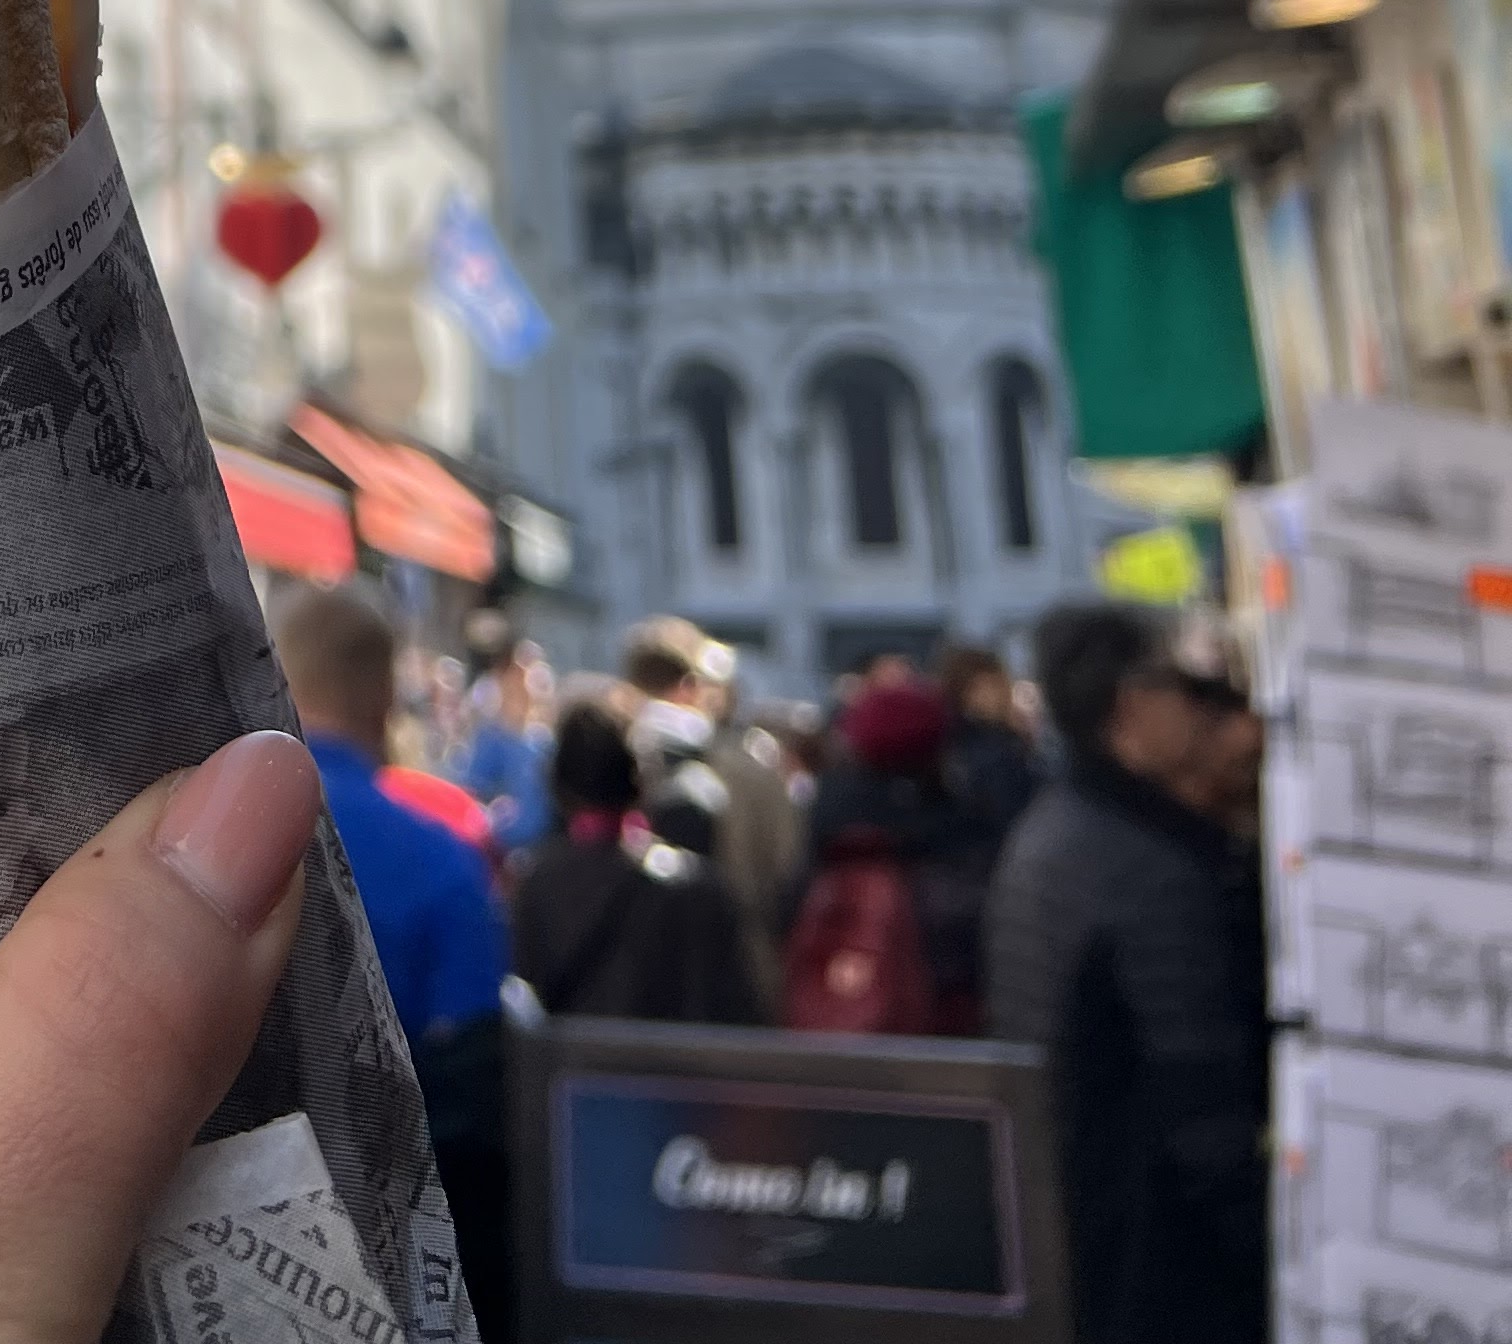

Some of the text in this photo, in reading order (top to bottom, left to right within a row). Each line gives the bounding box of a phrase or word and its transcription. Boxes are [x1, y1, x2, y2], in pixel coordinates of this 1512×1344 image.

[65, 220, 83, 254] de
[82, 197, 105, 233] issu
[18, 229, 66, 289] forêts
[653, 1135, 804, 1215] Come
